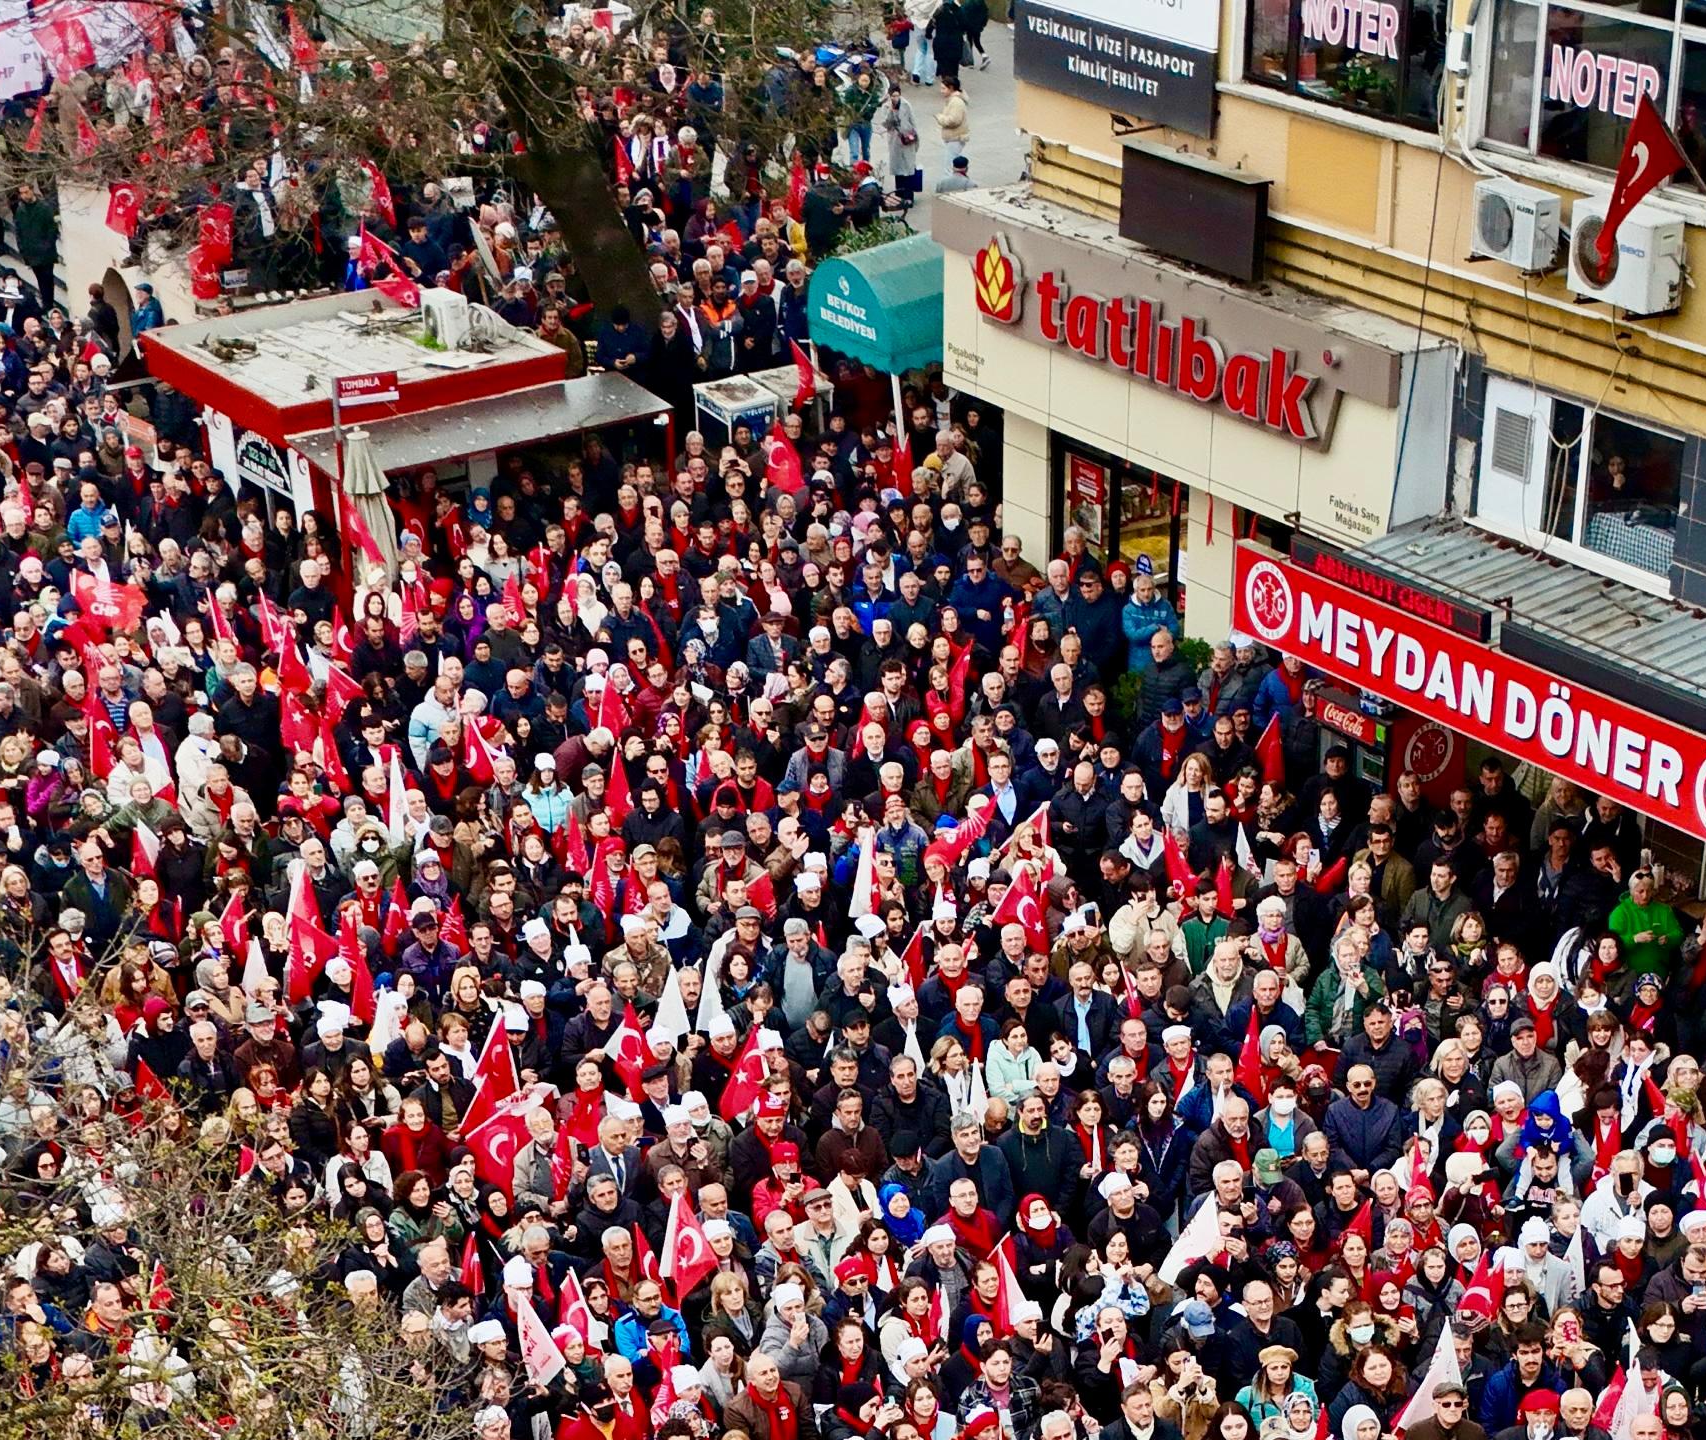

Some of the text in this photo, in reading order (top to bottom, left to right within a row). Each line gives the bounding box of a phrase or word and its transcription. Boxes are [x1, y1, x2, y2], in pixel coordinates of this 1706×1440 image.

[1028, 15, 1195, 78] VESİKALIK VİZE PASAPORT
[1301, 0, 1399, 60] NOTER
[1068, 55, 1160, 97] KİMLİK EHLİYET
[826, 292, 867, 321] BEYKOZ
[1037, 271, 1318, 440] tatlıbak
[340, 376, 381, 391] TOMBALA
[1329, 494, 1359, 517] Fabrika
[1299, 590, 1685, 808] MEYDAN DÖNER
